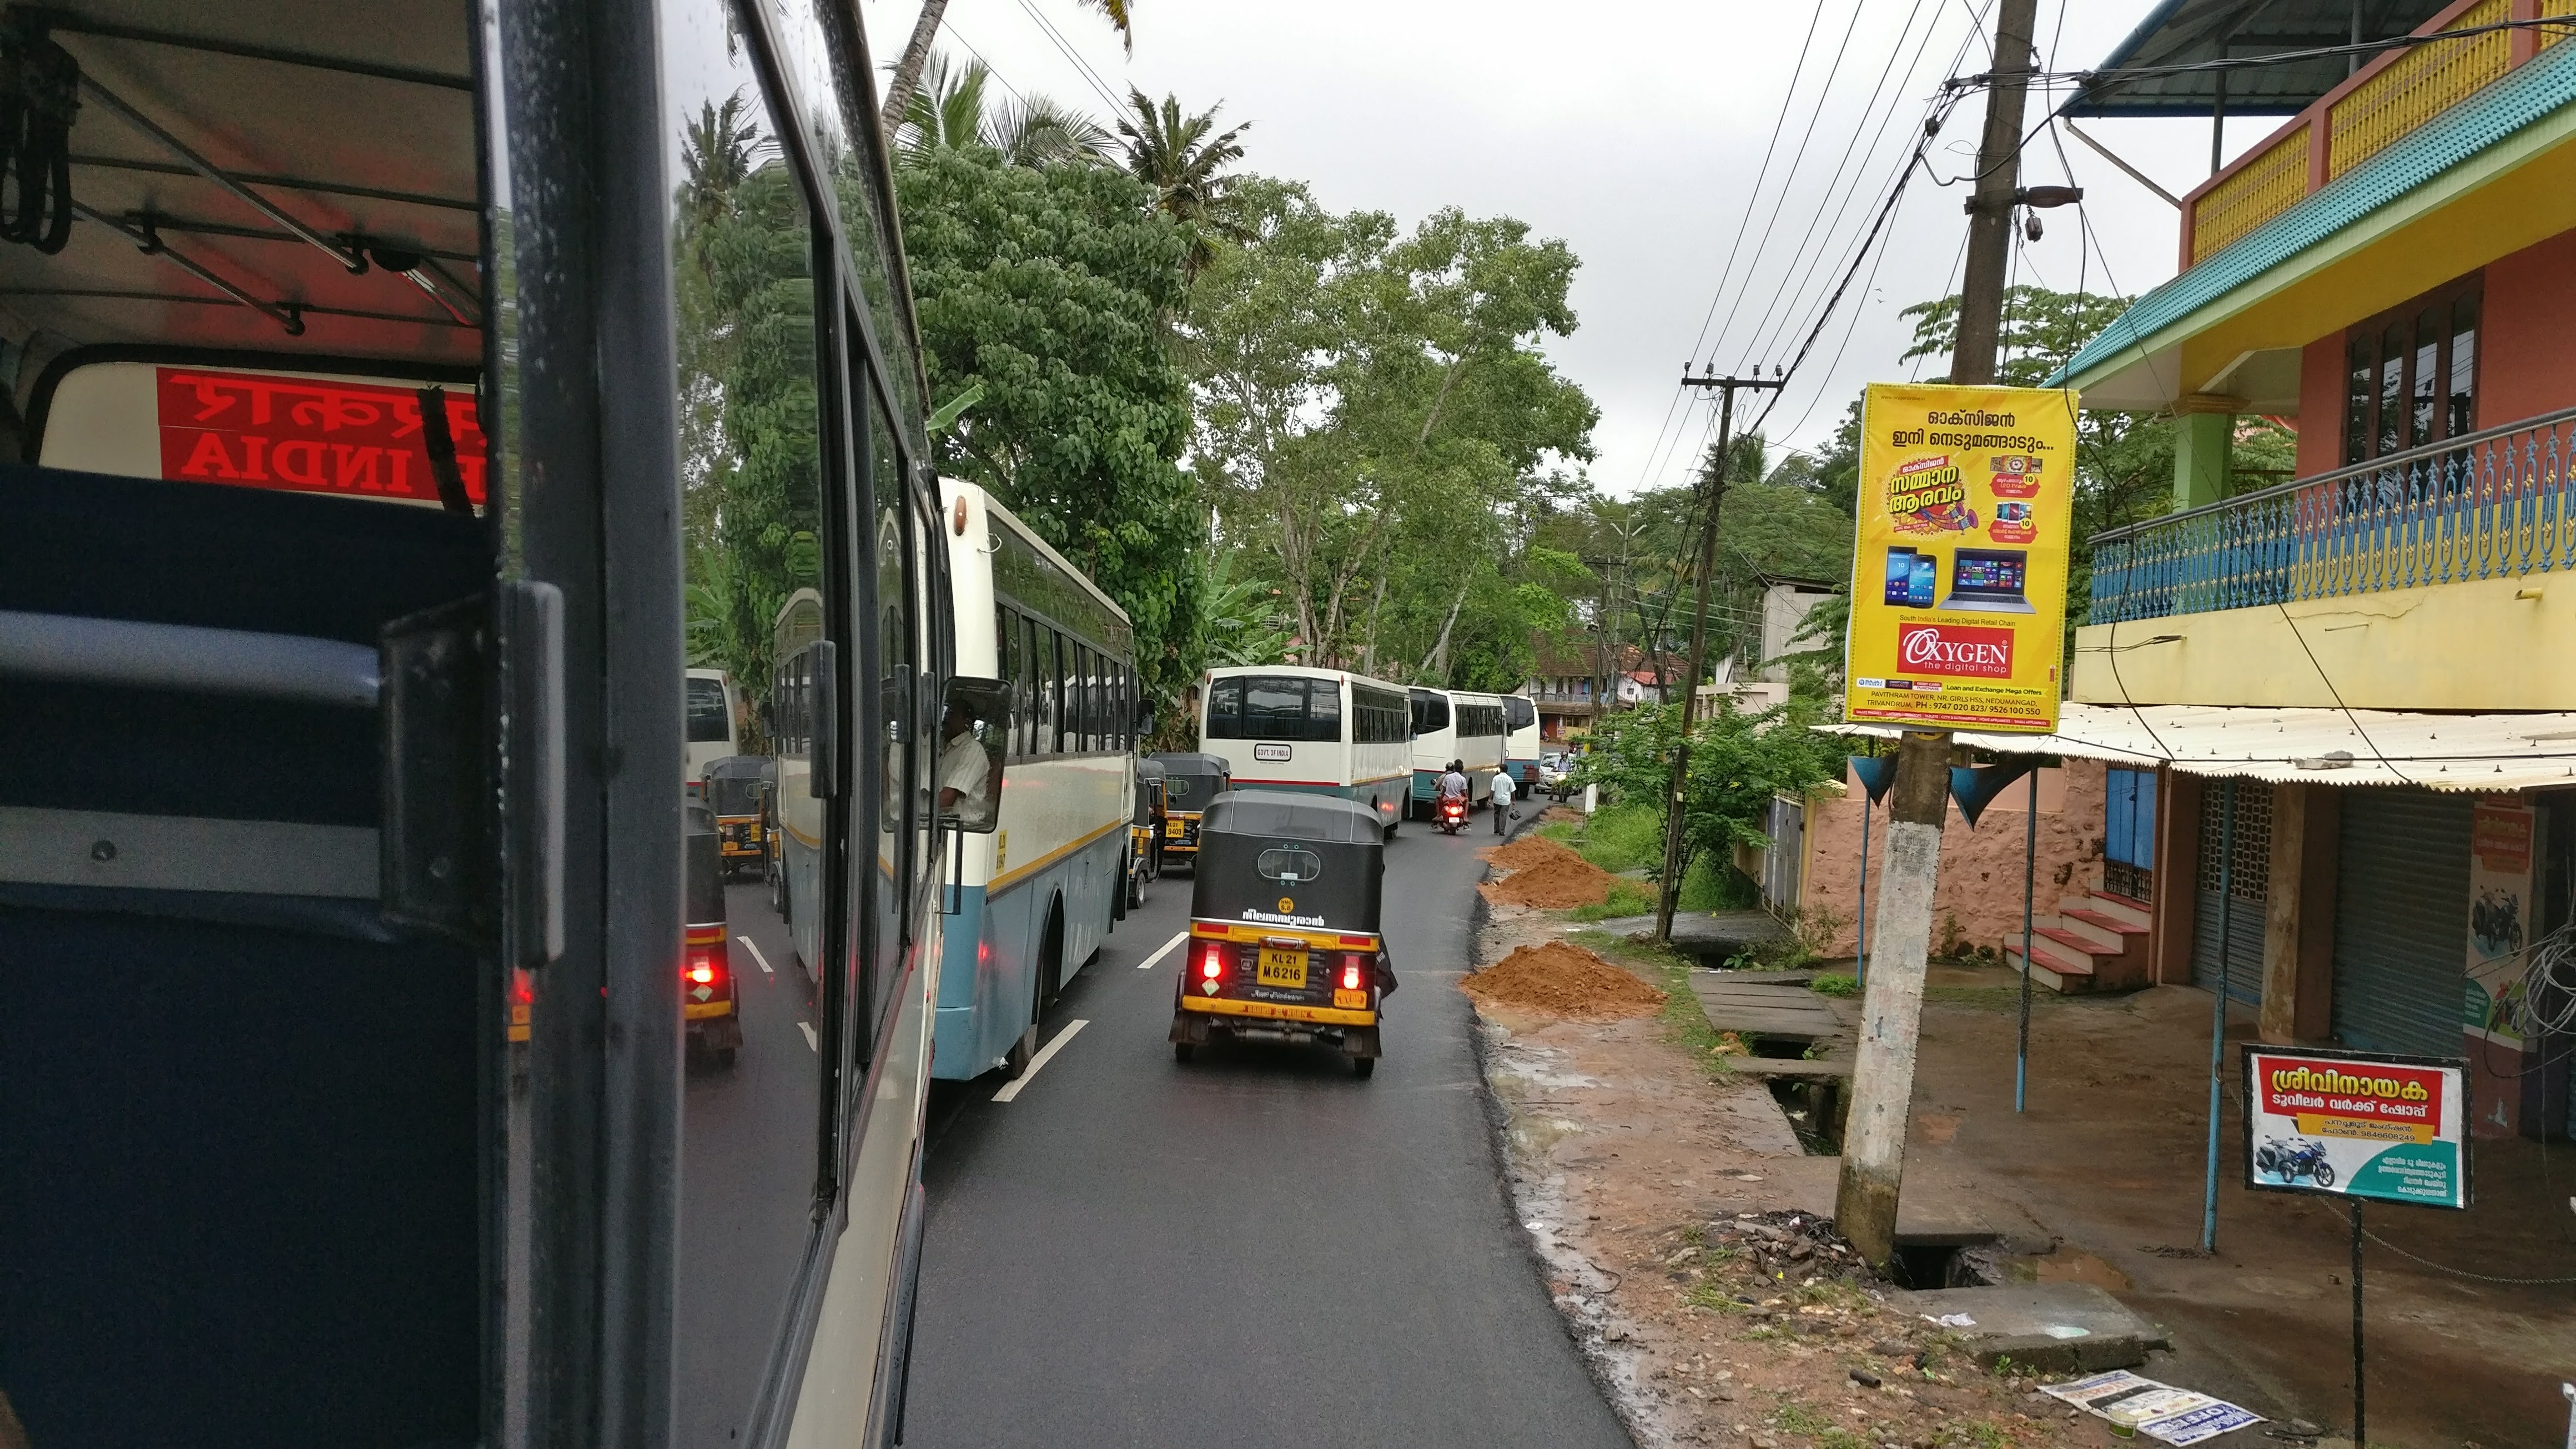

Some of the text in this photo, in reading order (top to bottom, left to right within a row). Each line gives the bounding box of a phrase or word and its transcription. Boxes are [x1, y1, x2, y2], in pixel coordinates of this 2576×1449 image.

[1928, 409, 2015, 427] ഓക്സിജൻ
[1893, 427, 1924, 447] ഇനി
[1903, 457, 1944, 473] ഓക്സിജൻ
[1890, 466, 1958, 494] സമ്മാന
[1889, 485, 1963, 514] ആരവം
[1937, 617, 1960, 625] Leading
[1903, 628, 2009, 665] OXYGEN
[1924, 661, 2007, 674] the digital shop
[1867, 700, 1913, 709] TRIVANDRUM,
[1871, 691, 1909, 699] PAVITHRAM
[1985, 698, 2037, 707] NEDUMANGAD,
[1271, 953, 1296, 964] KL 21
[2271, 1066, 2429, 1101] ശ്രീവിനായക
[2379, 1103, 2428, 1118] ഷോപ്പ്
